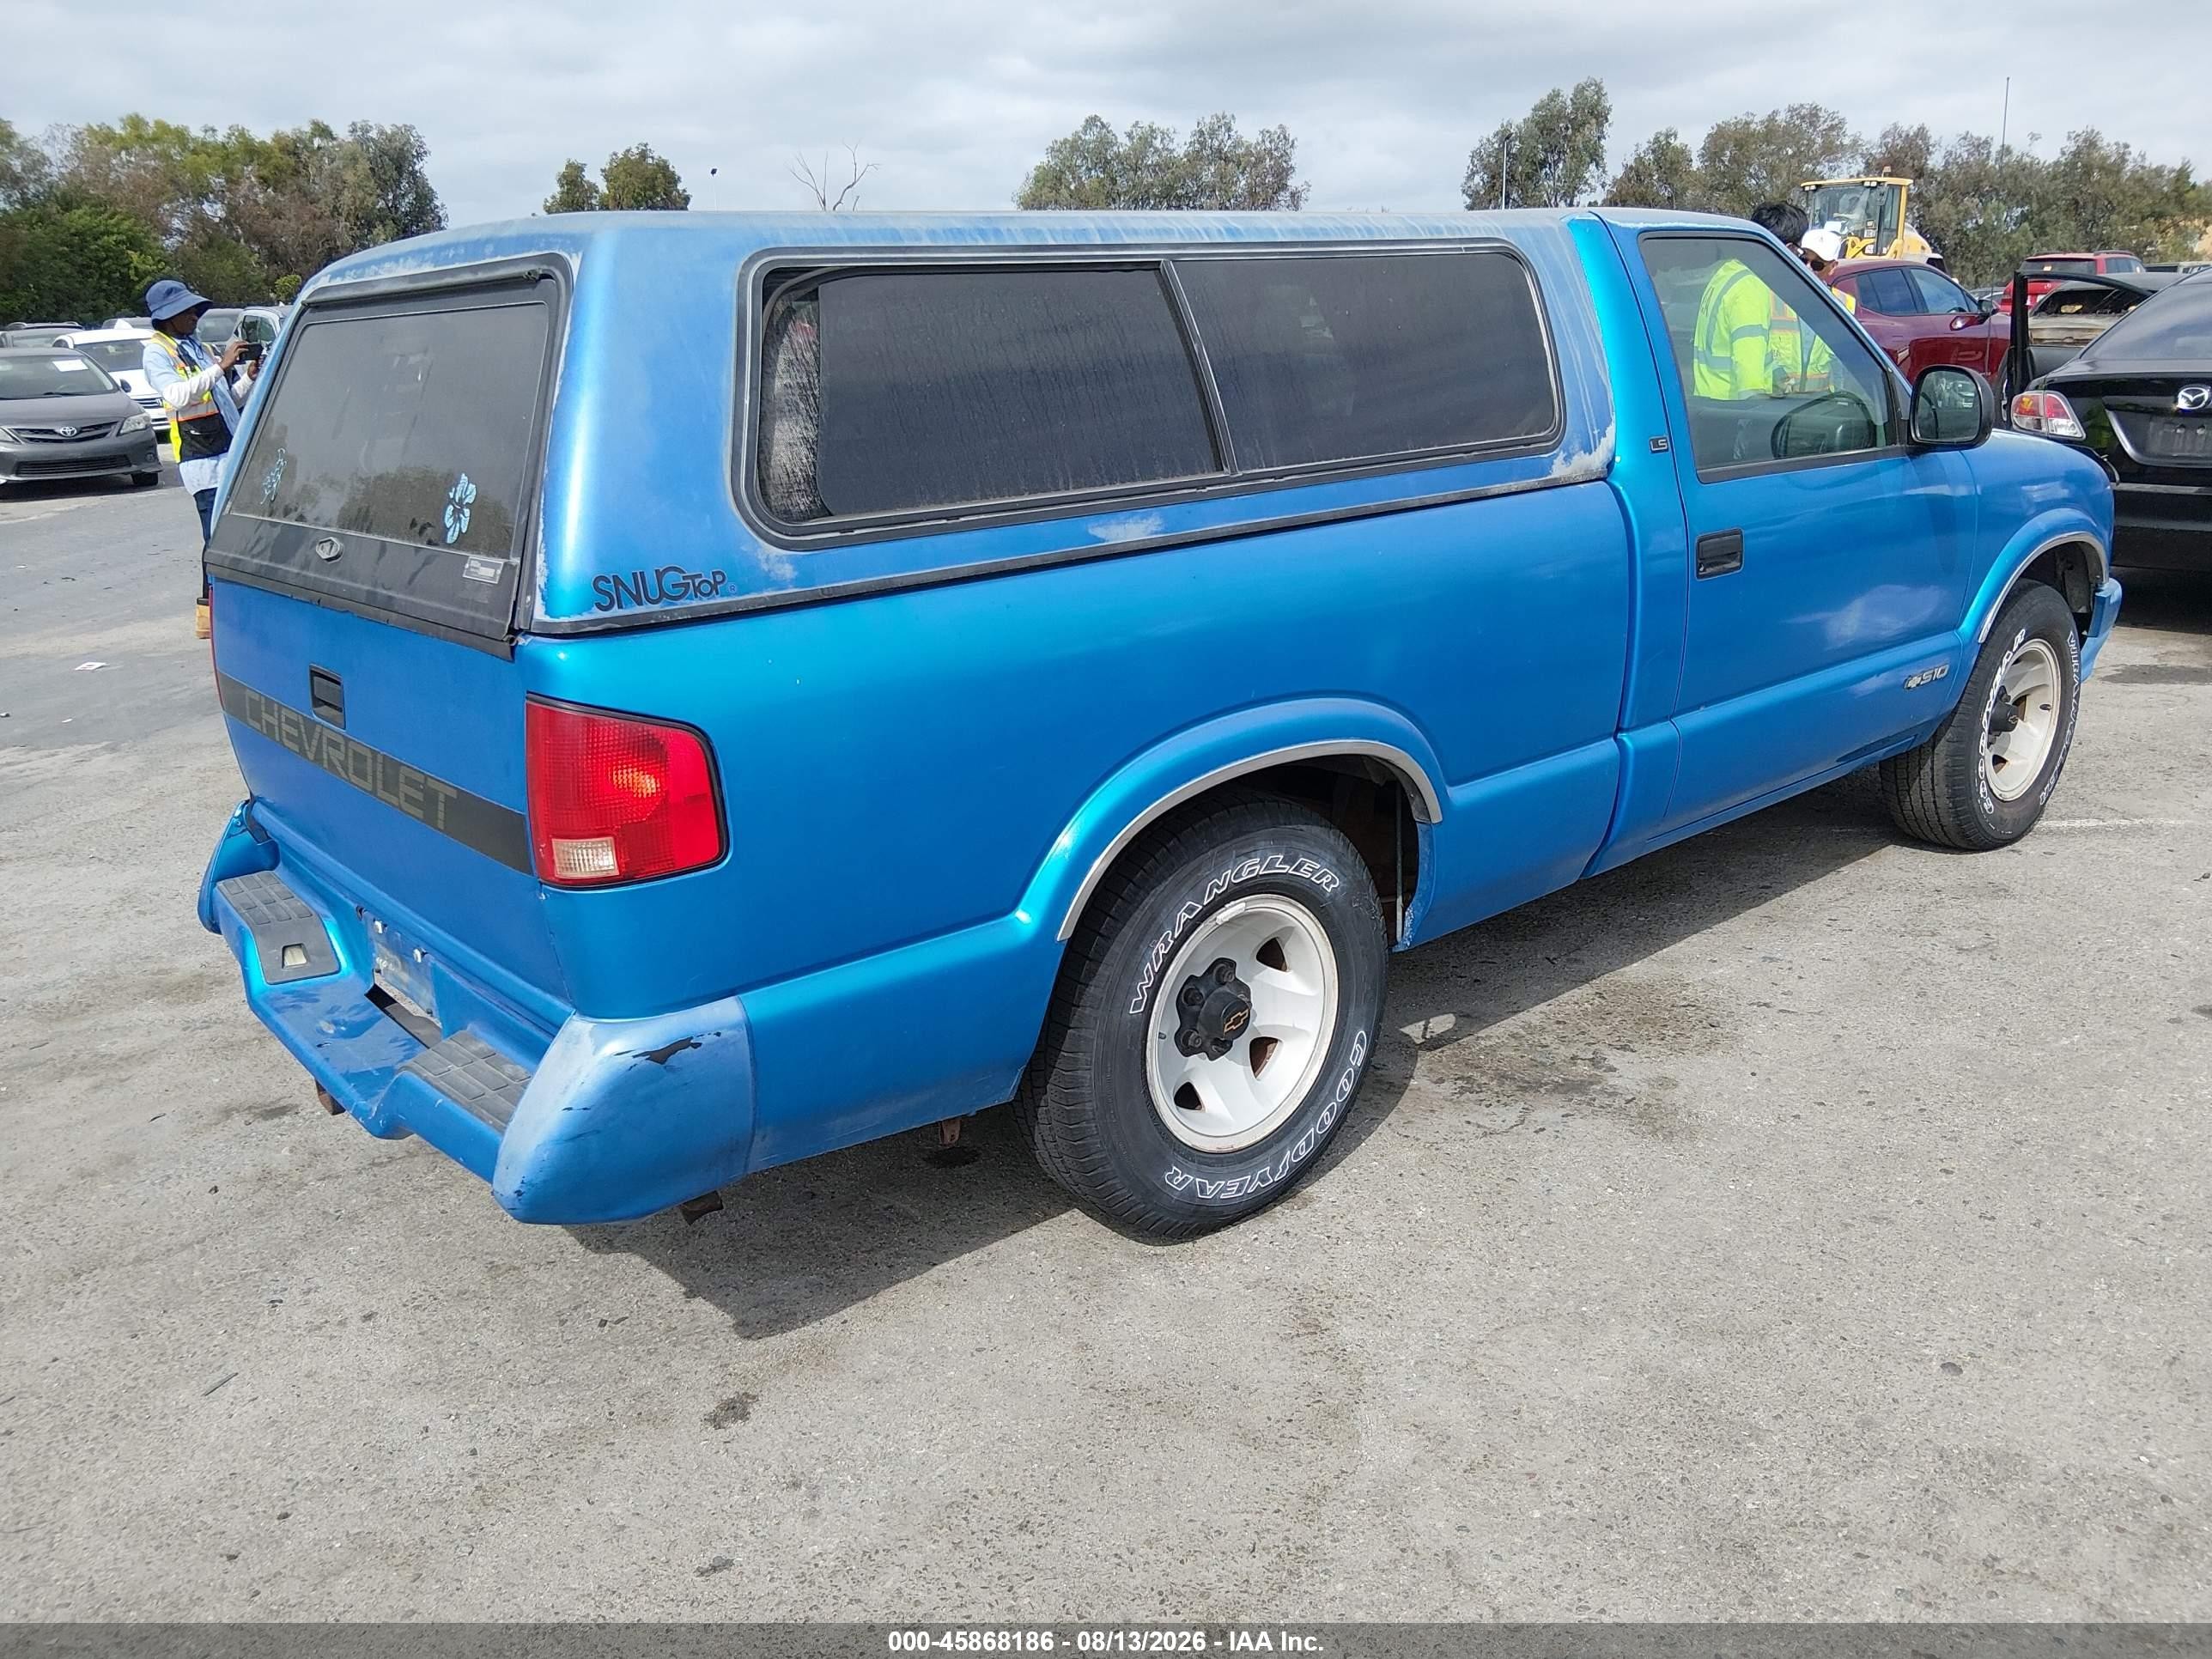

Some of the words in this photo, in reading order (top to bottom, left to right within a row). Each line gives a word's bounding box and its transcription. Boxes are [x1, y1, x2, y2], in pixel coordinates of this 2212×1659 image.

[1650, 438, 1668, 452] LS
[246, 688, 458, 830] CHEVROLET
[1128, 854, 1341, 1014] WRANGLER
[1164, 1030, 1368, 1199] GOODYEAR
